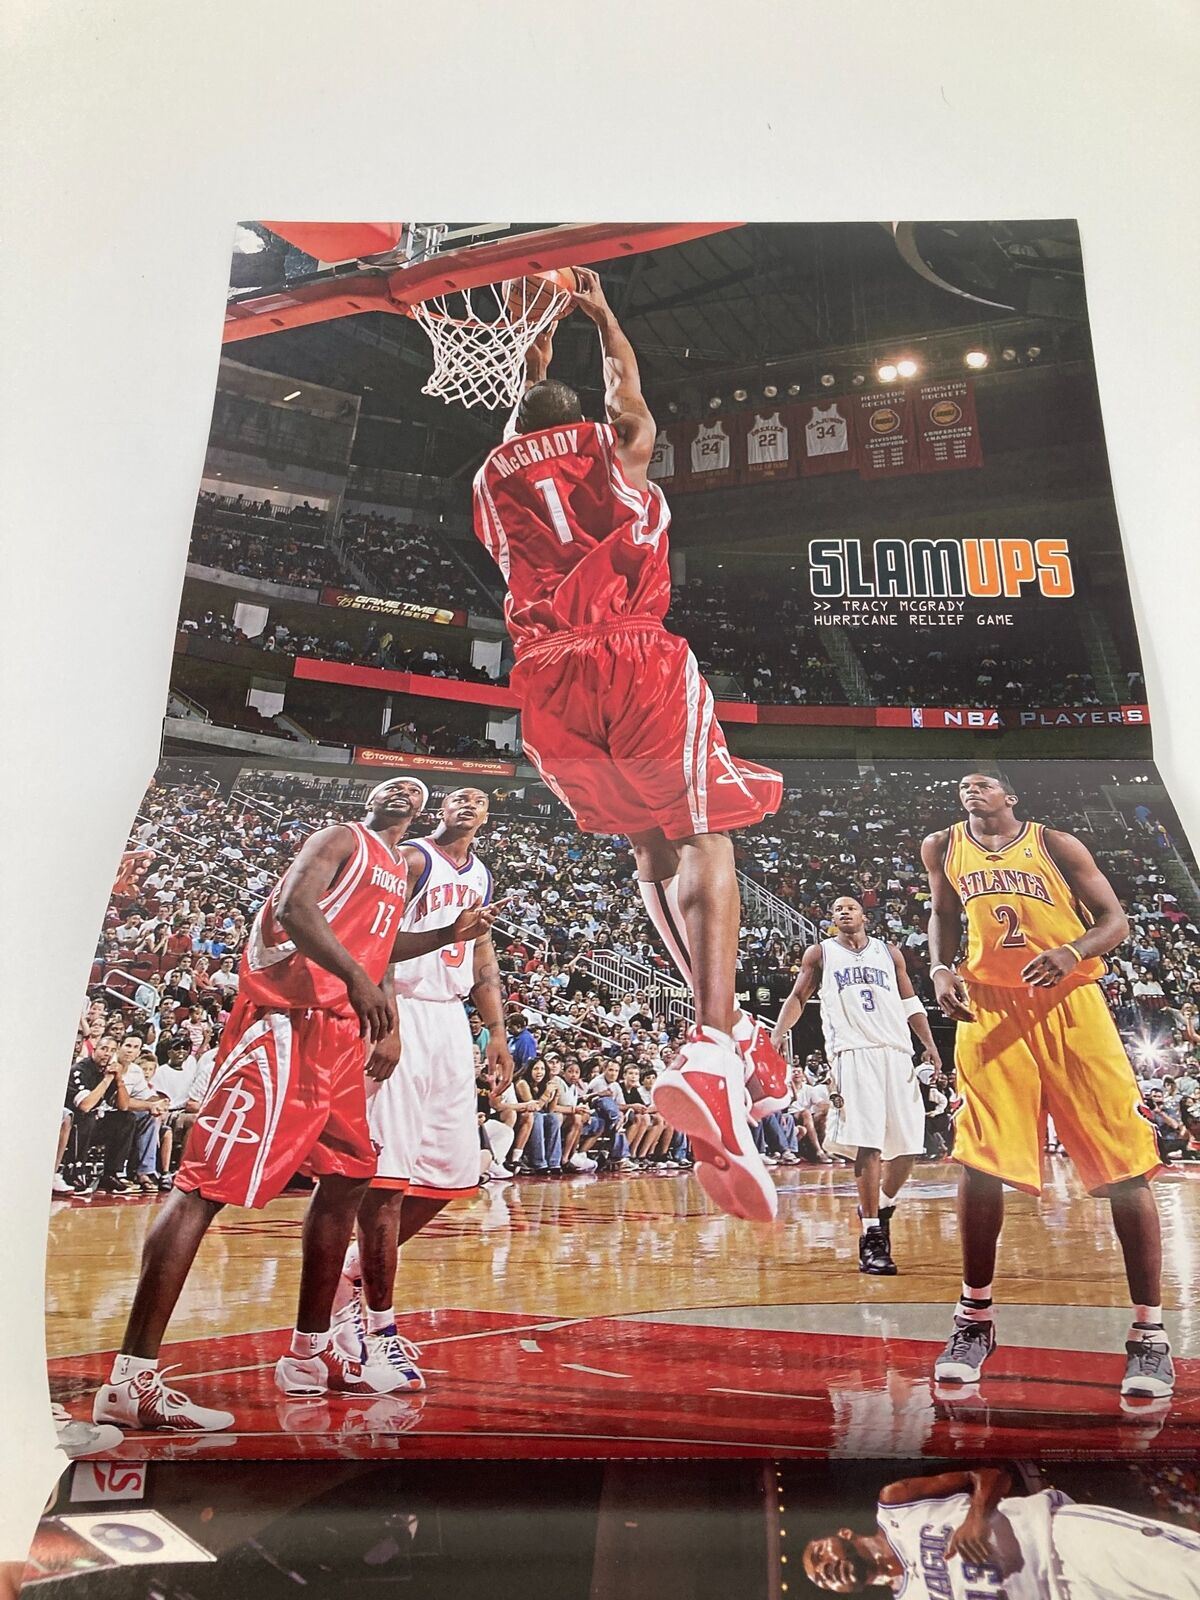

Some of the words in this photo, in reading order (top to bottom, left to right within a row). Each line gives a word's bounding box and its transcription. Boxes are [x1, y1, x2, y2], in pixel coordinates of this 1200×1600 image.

[759, 434, 777, 447] 22
[816, 424, 836, 439] 34
[491, 429, 578, 478] McGRADY
[702, 441, 719, 455] 24
[535, 477, 574, 545] 1
[351, 602, 431, 621] BUDWEISER
[355, 595, 402, 609] GAME
[402, 602, 438, 615] TIME
[843, 601, 888, 611] TRACY
[900, 601, 965, 612] MCGRADY
[814, 615, 898, 626] HURRICANE
[909, 615, 964, 626] RELIEF
[976, 615, 1014, 626] GAME
[943, 710, 1005, 726] NBA
[1020, 709, 1143, 726] PLAYERS
[374, 752, 405, 762] TOYOTA
[425, 758, 454, 766] TOYOTA
[958, 868, 1055, 906] ATLANTA
[370, 901, 396, 939] 13
[995, 904, 1027, 948] 2
[834, 966, 891, 993] MAGIC
[860, 989, 876, 1012] 3
[920, 1524, 955, 1600] AGIC
